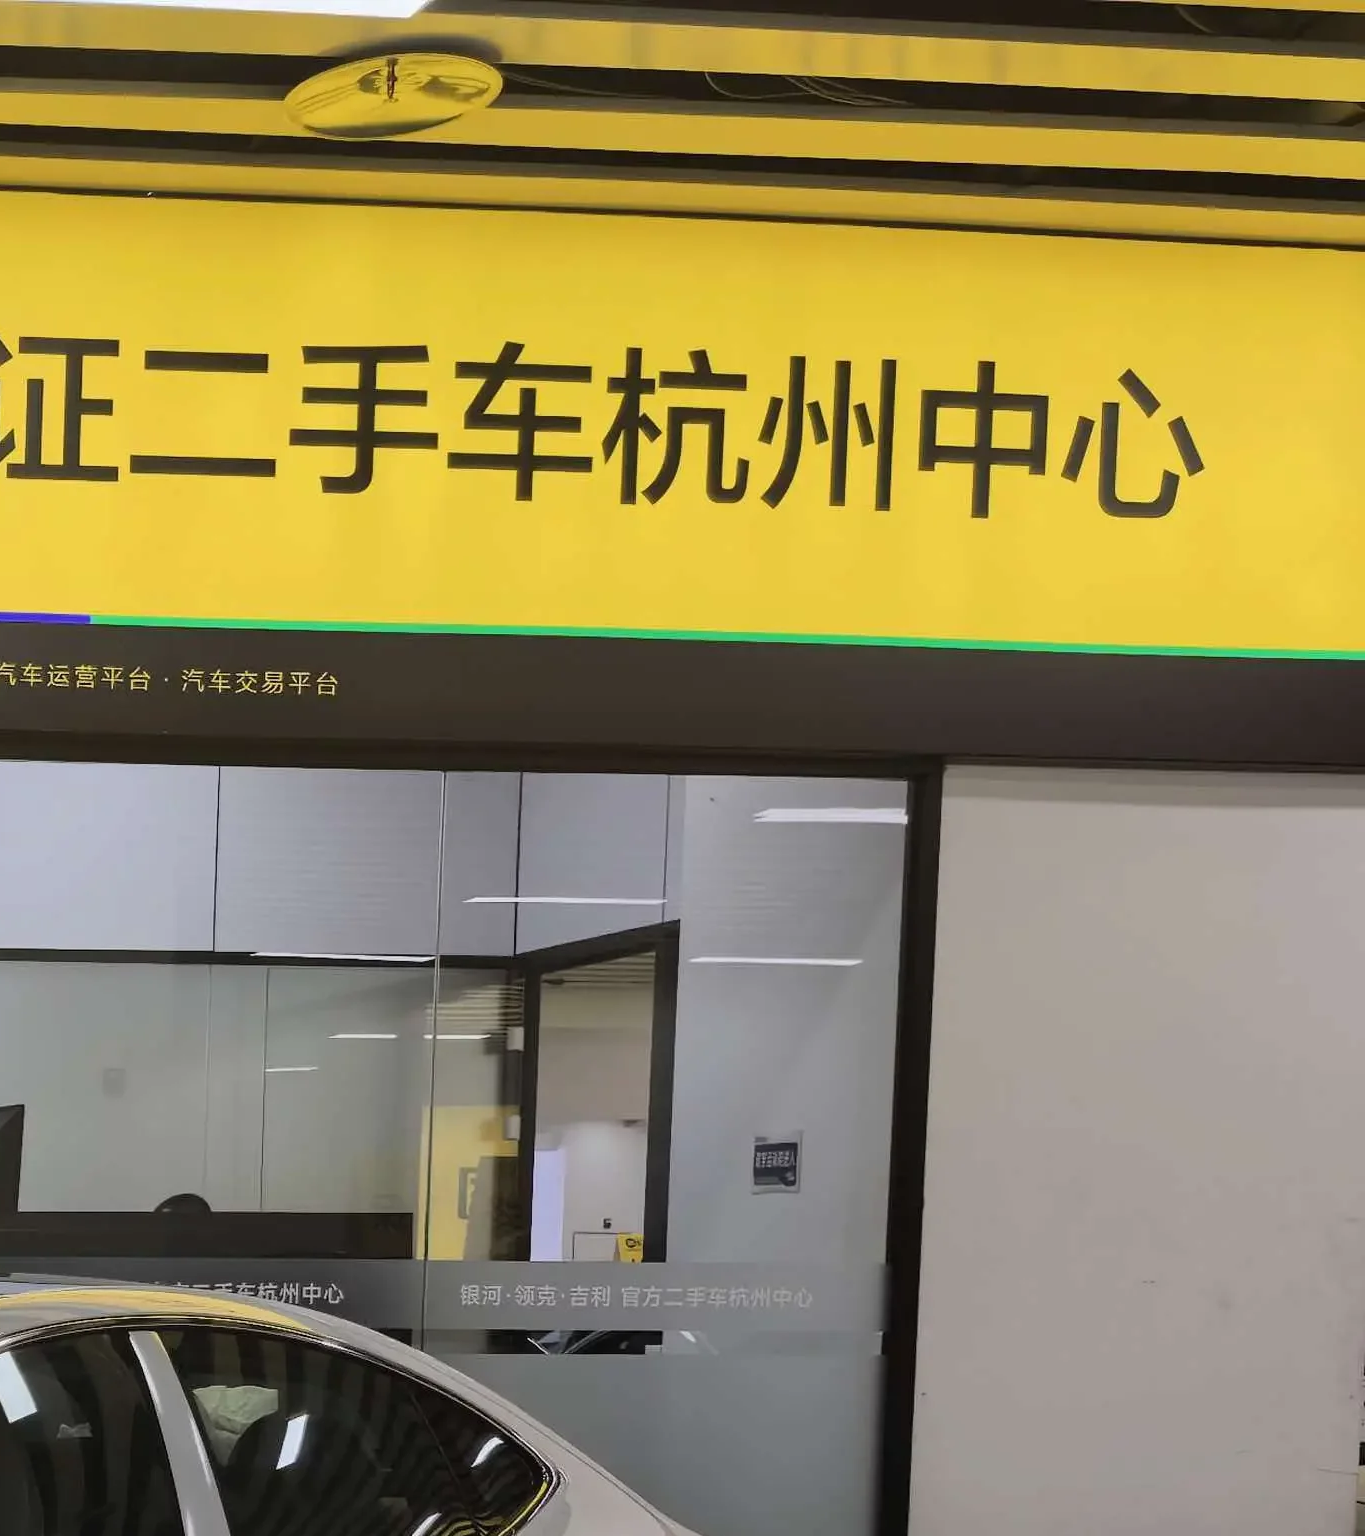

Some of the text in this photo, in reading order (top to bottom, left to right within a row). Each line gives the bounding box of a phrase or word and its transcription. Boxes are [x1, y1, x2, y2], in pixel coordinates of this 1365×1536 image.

[620, 1287, 814, 1309] 官方二手车杭州中心
